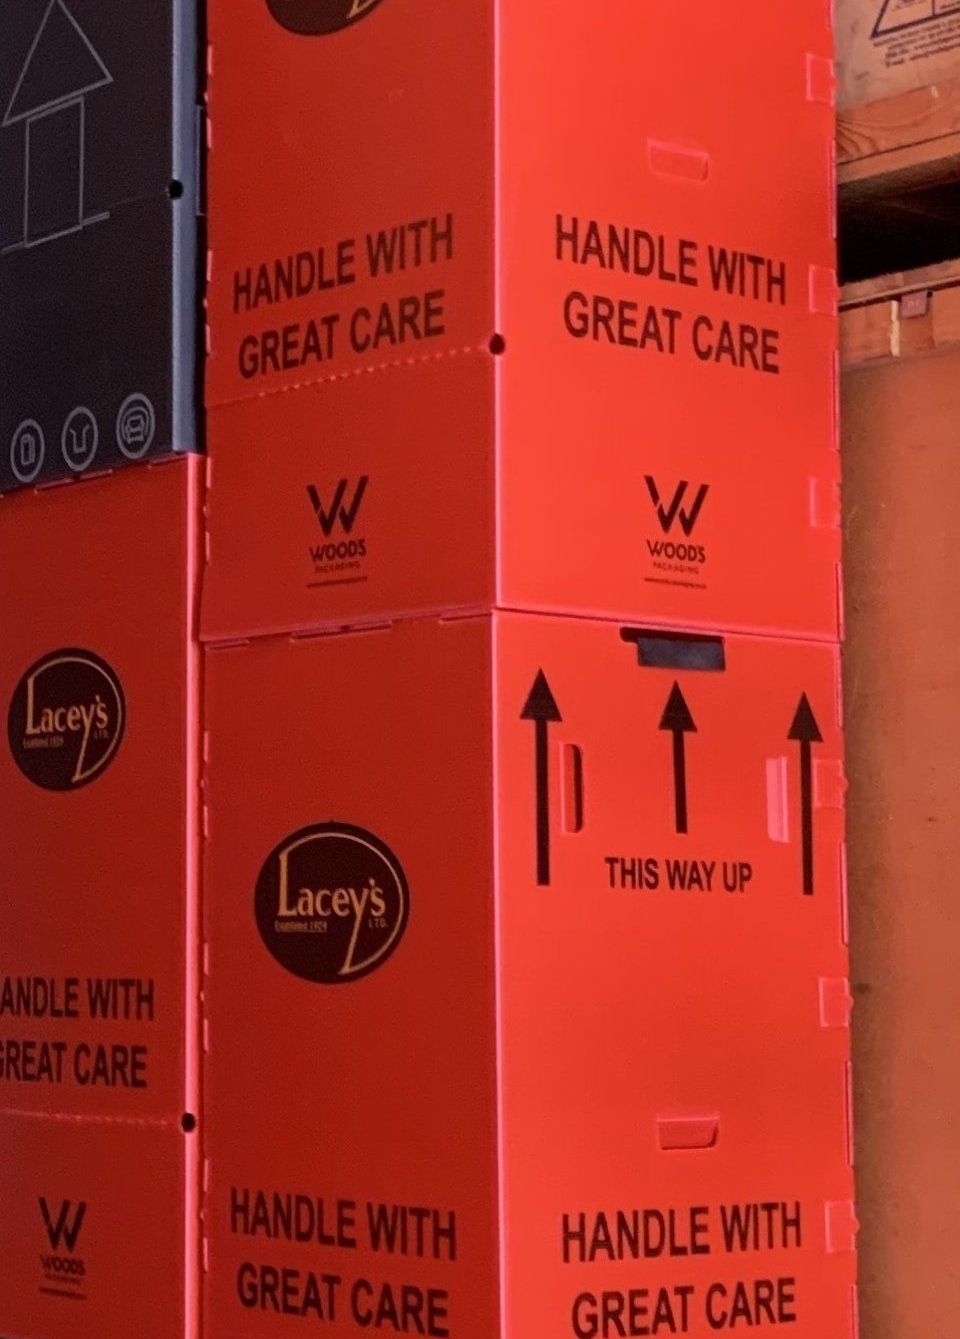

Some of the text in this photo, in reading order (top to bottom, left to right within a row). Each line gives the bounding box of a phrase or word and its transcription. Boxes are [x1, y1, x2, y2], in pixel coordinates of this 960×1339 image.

[233, 213, 454, 314] HANDLE WITH
[555, 214, 787, 306] HANDLE WITH
[238, 290, 445, 379] GREAT CARE
[564, 292, 780, 375] GREAT CARE
[605, 856, 752, 893] THIS WAY UP
[87, 977, 154, 1020] WITH
[74, 1044, 147, 1088] CARE
[231, 1186, 457, 1260] HANDLE WITH
[562, 1201, 801, 1263] HANDLE WITH
[237, 1261, 449, 1339] GREAT CARE
[705, 1277, 797, 1329] CARE
